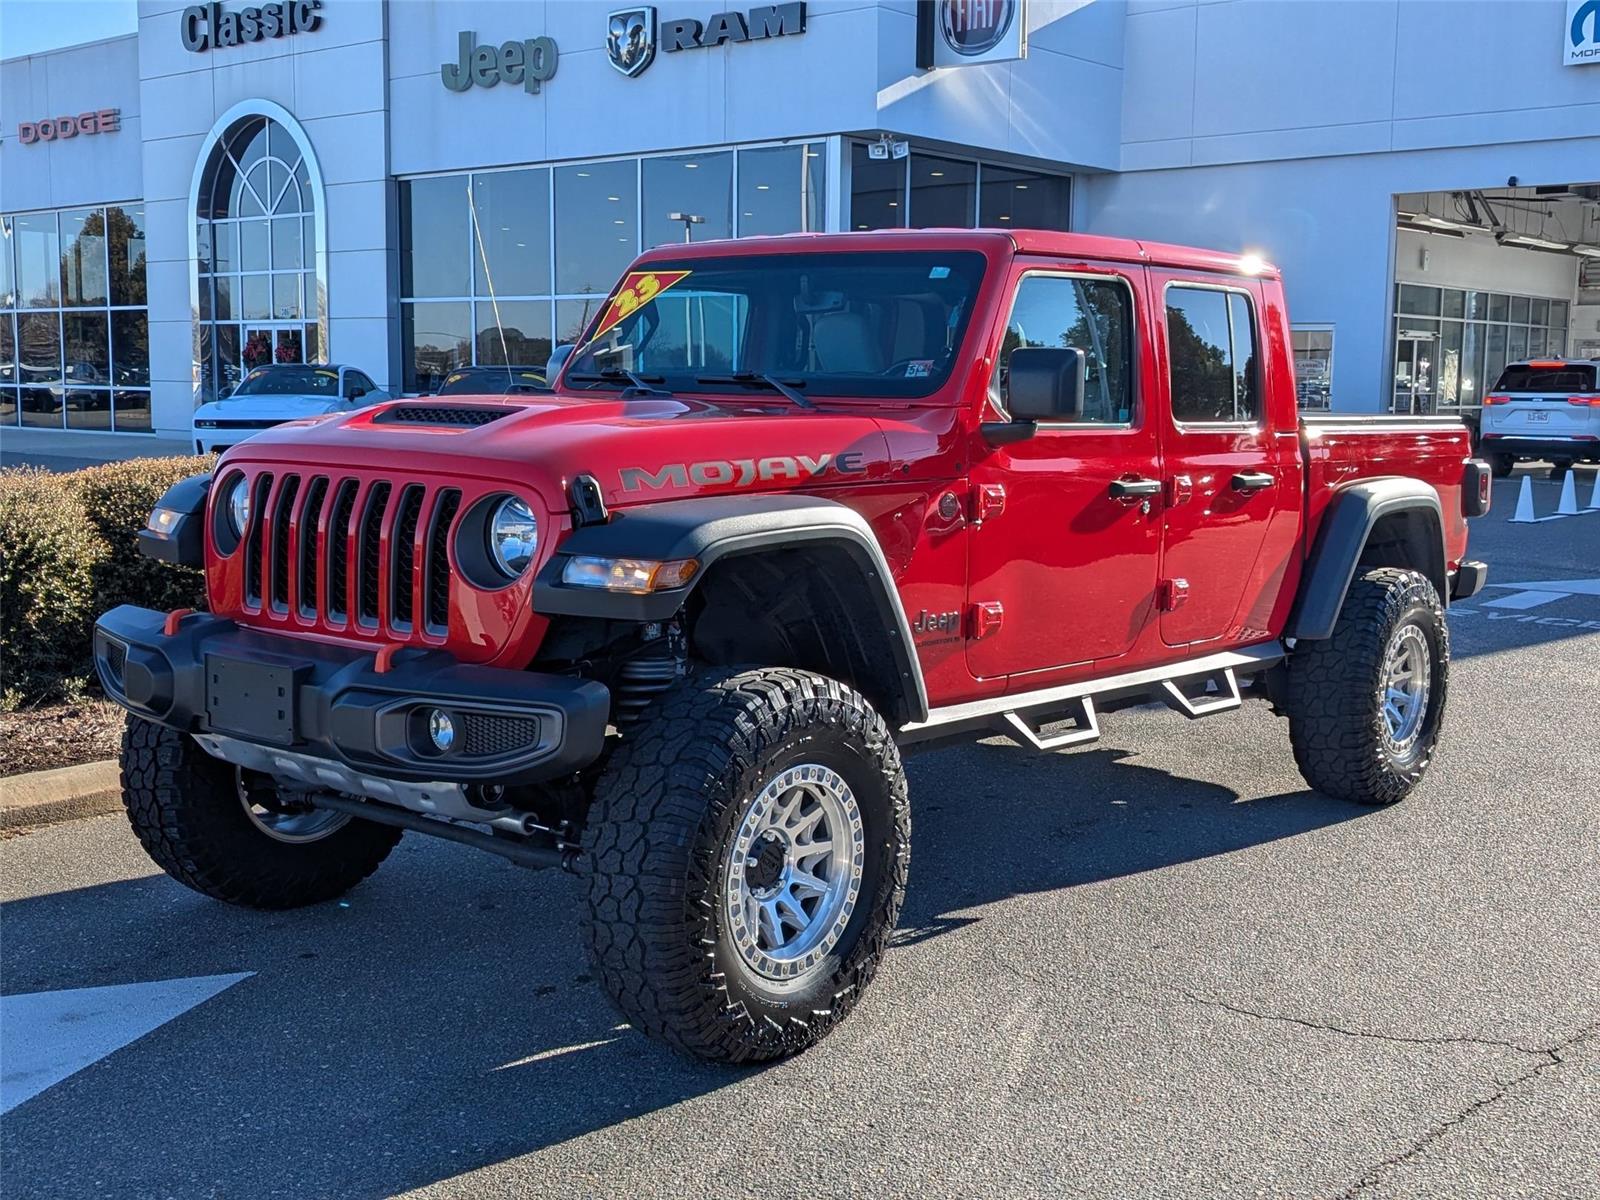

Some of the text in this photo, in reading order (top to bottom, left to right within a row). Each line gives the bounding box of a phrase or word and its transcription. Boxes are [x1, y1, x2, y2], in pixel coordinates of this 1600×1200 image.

[181, 0, 322, 52] Classic
[661, 2, 807, 53] RAM
[441, 31, 559, 94] Jeep
[18, 108, 120, 145] DODGE
[615, 274, 660, 317] 23
[618, 452, 867, 493] MOJAVE
[913, 609, 960, 634] Jeep
